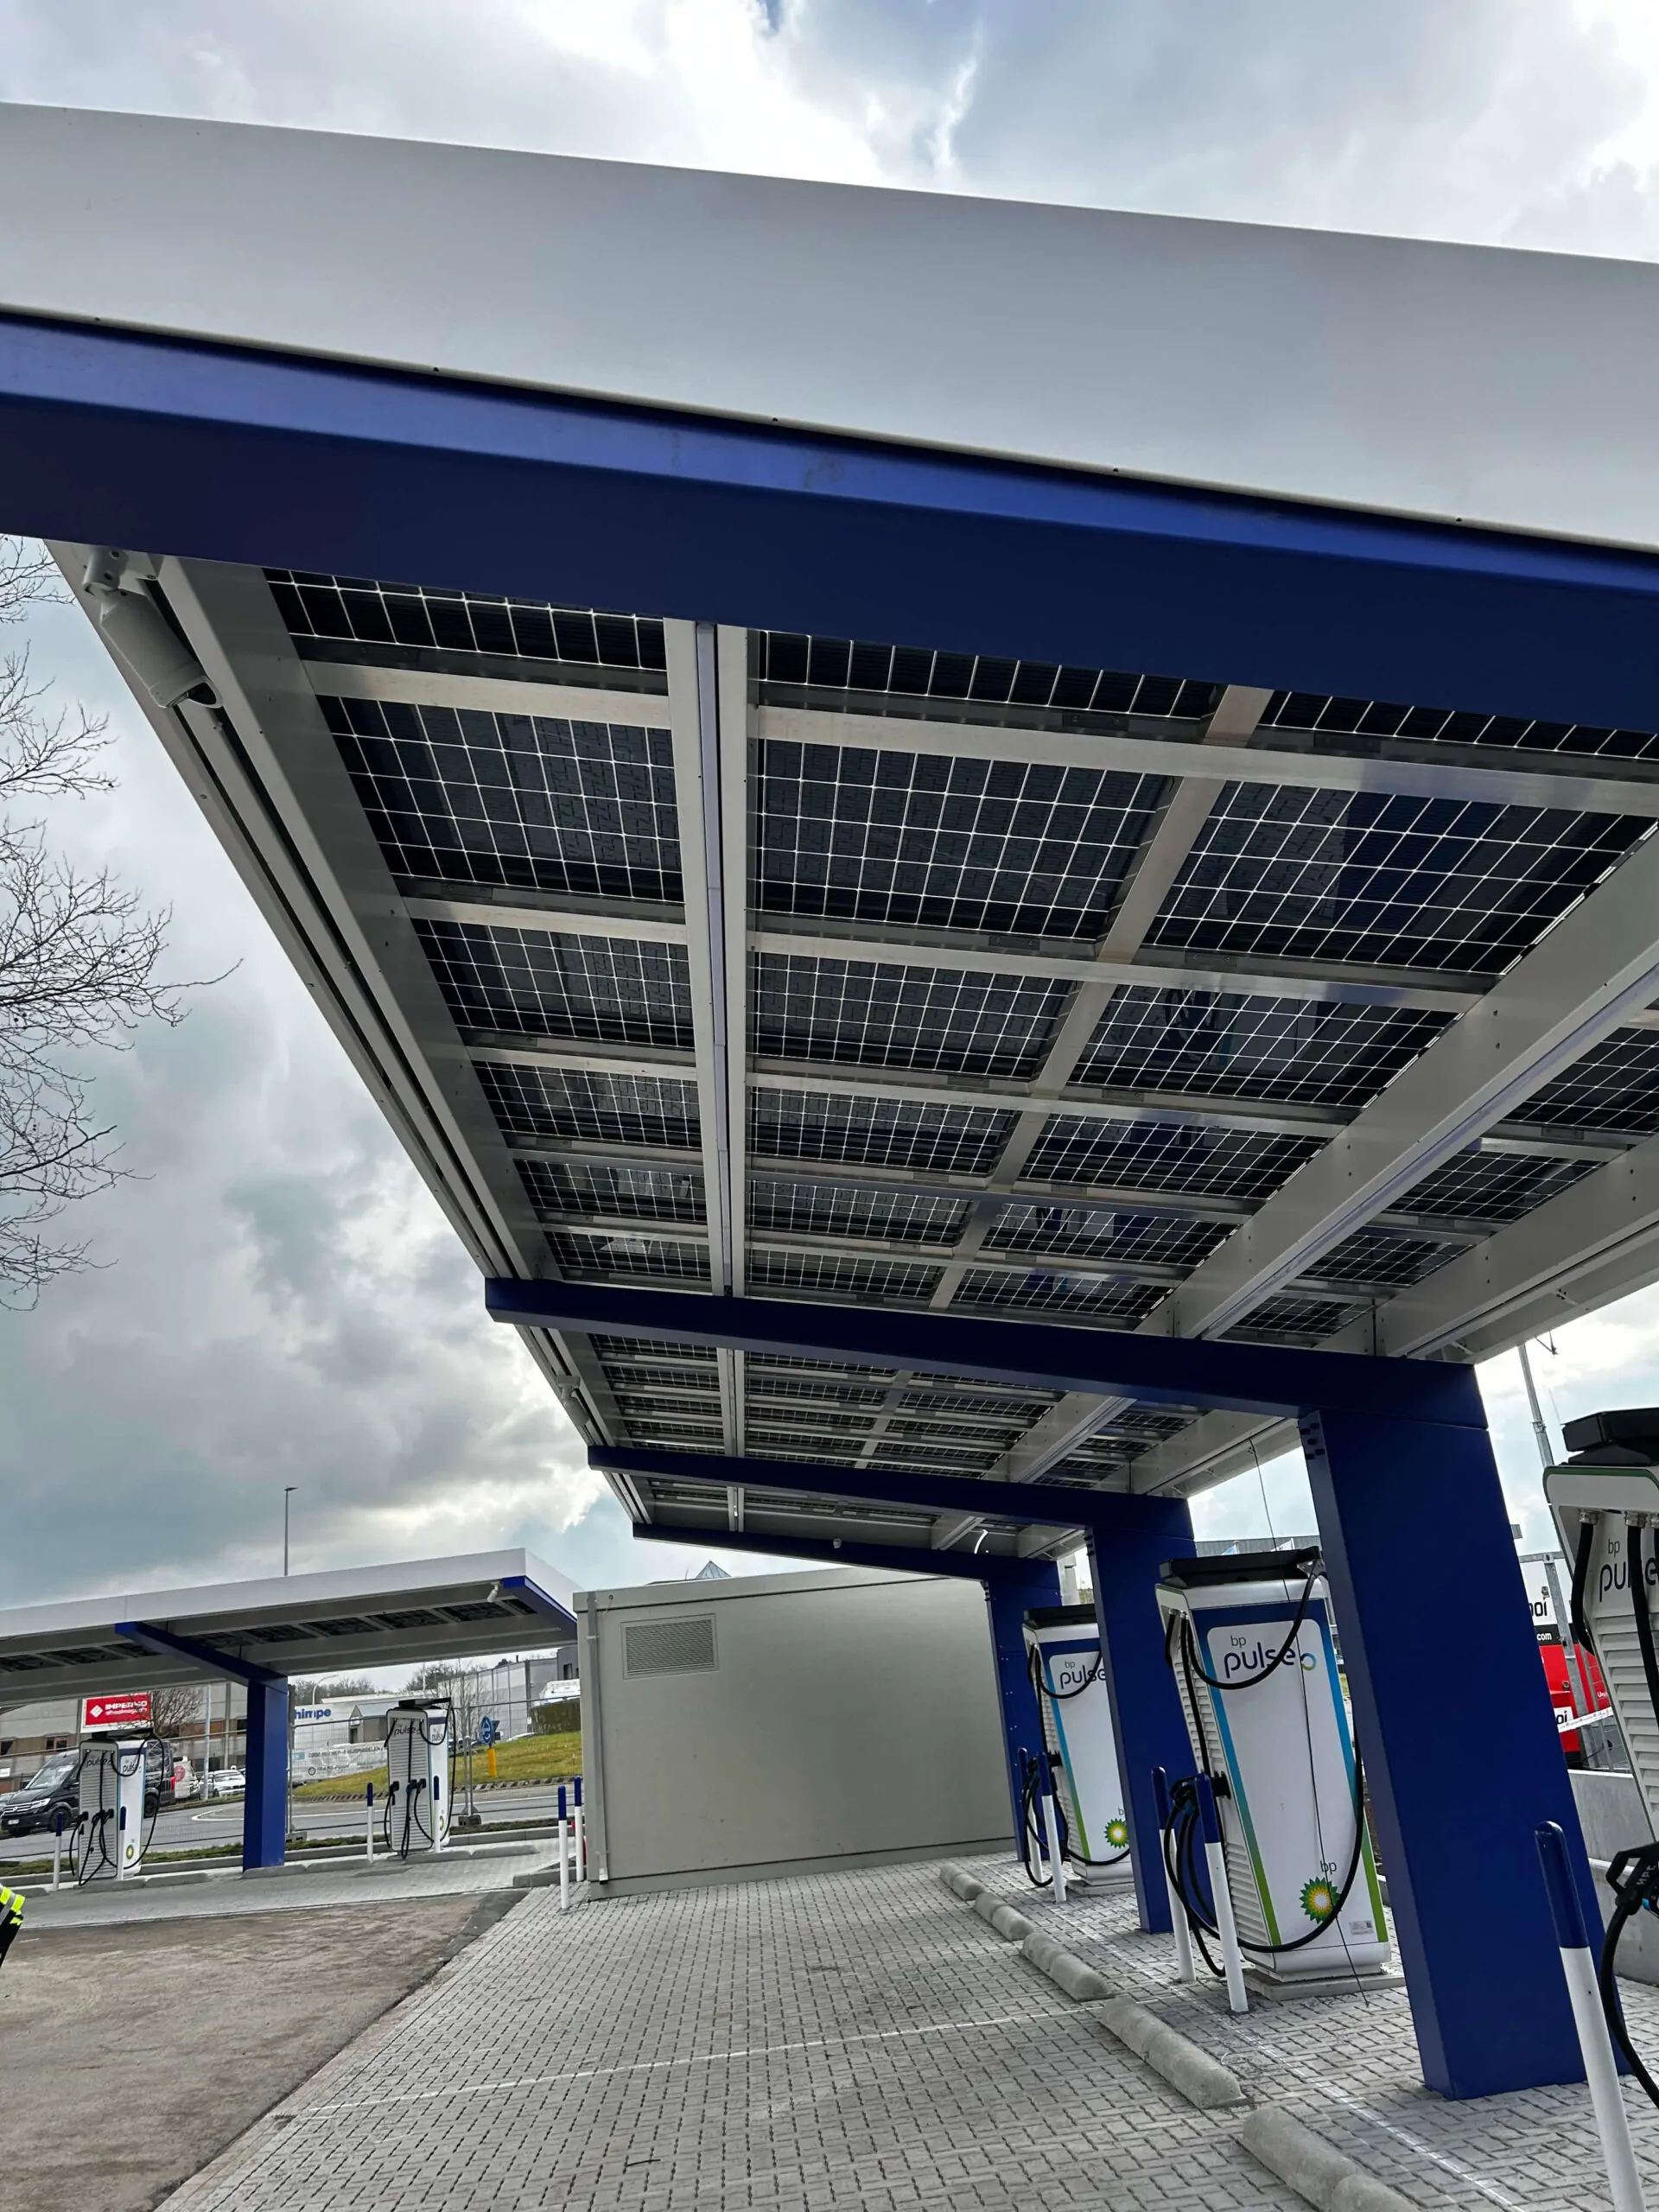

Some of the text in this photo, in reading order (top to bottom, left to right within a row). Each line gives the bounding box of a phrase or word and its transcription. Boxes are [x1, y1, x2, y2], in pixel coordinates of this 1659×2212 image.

[1608, 1538, 1620, 1558] bp
[1599, 1558, 1658, 1603] pule
[1230, 1635, 1247, 1648] bp
[1536, 1632, 1553, 1641] com
[1224, 1642, 1296, 1679] pulse
[1320, 1860, 1338, 1875] bp
